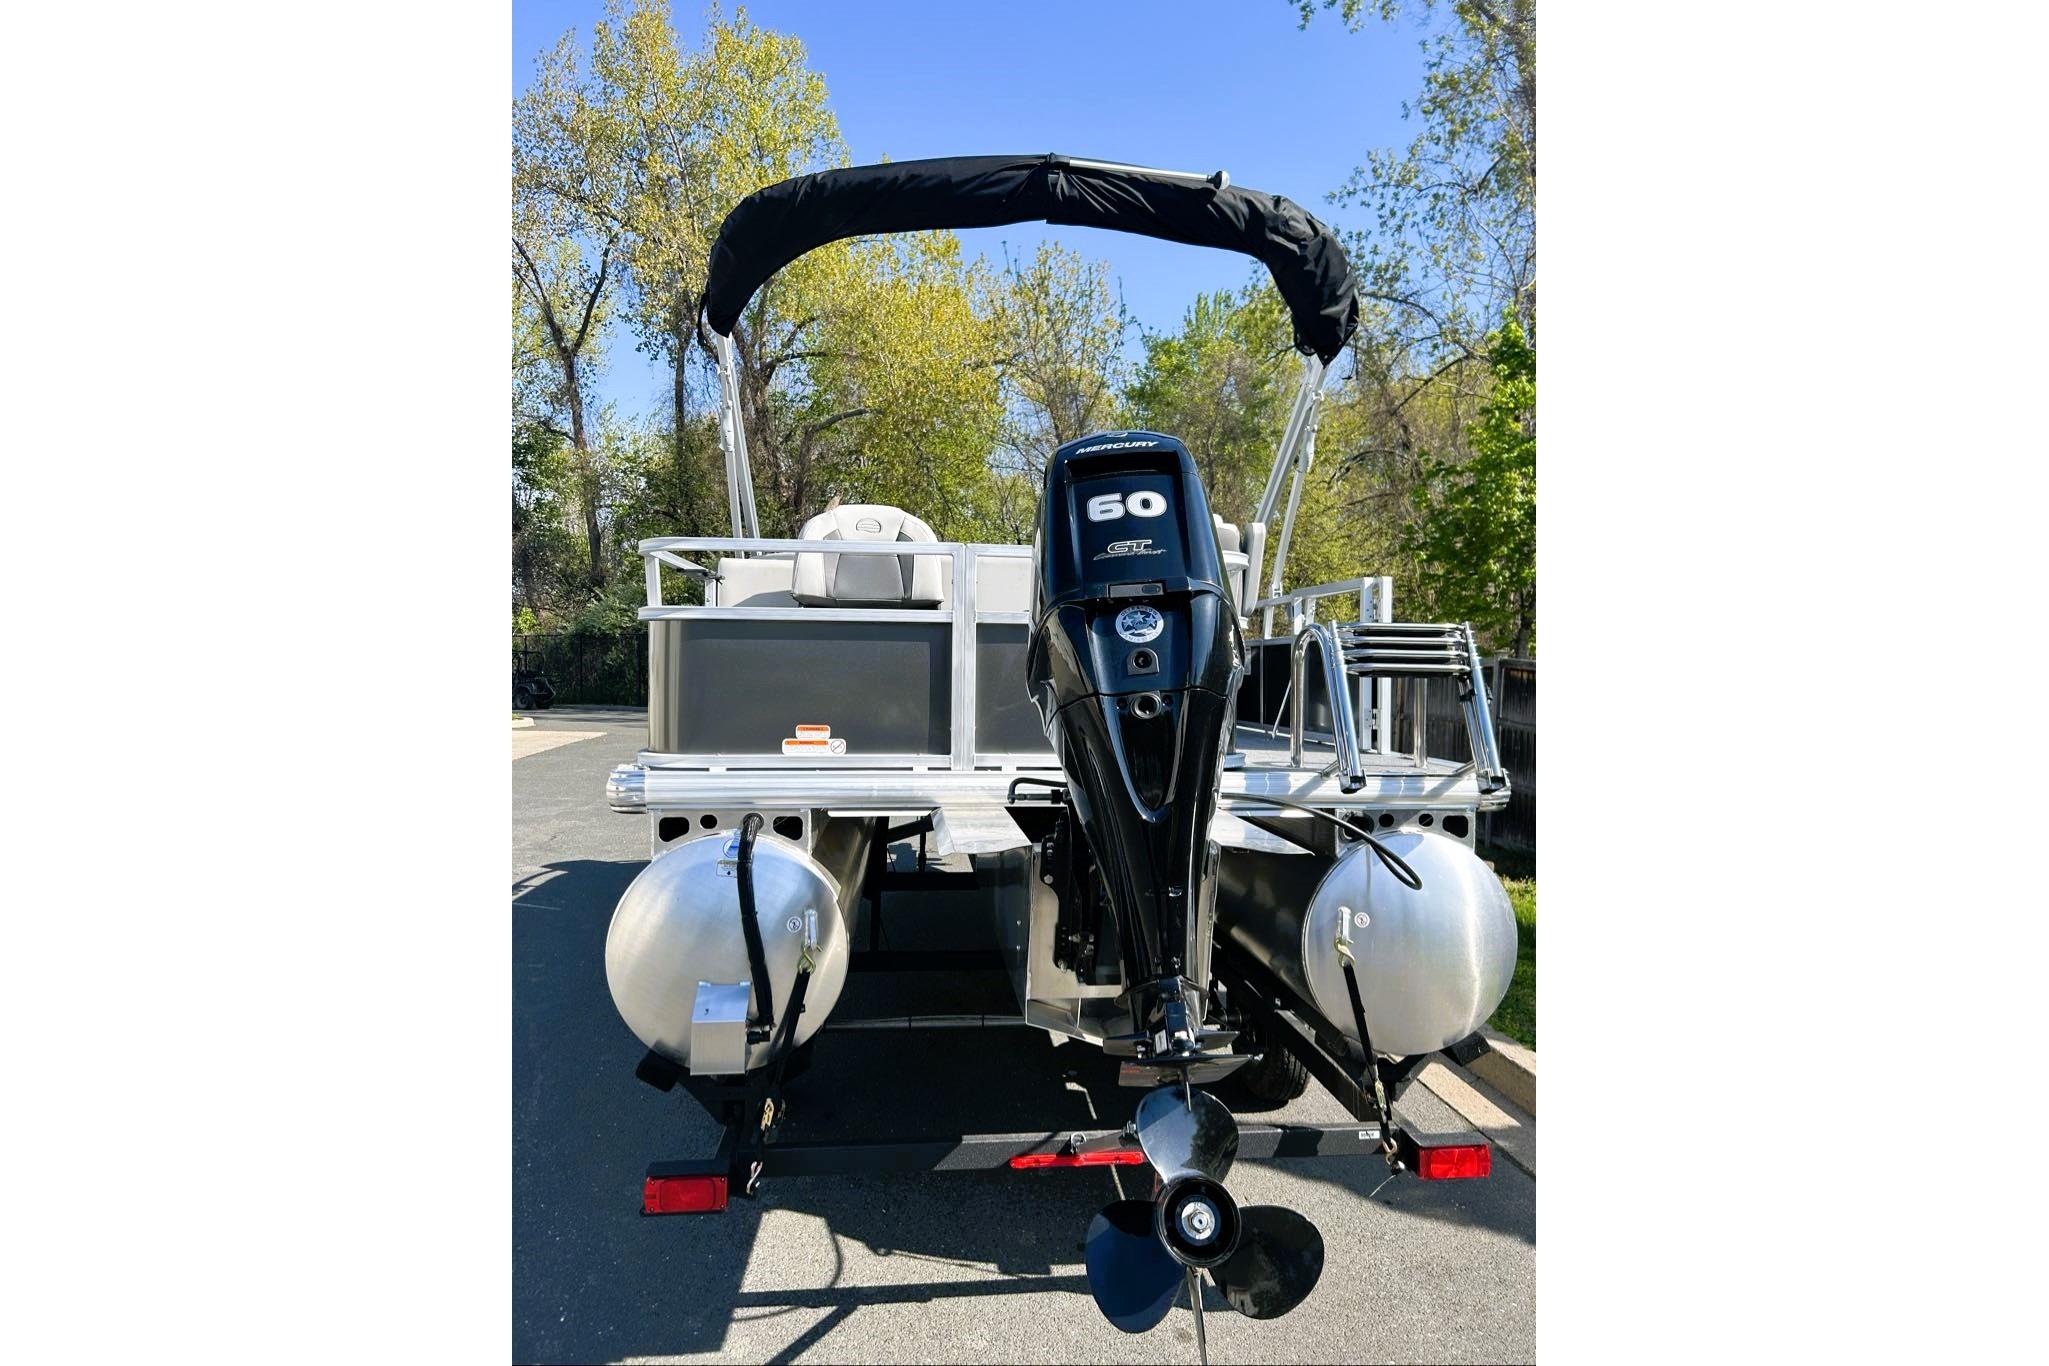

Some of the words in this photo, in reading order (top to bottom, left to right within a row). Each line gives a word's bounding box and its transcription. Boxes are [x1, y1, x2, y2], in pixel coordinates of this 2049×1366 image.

[1075, 441, 1160, 455] MERCURY
[1086, 490, 1168, 523] 60
[1107, 539, 1152, 554] GT
